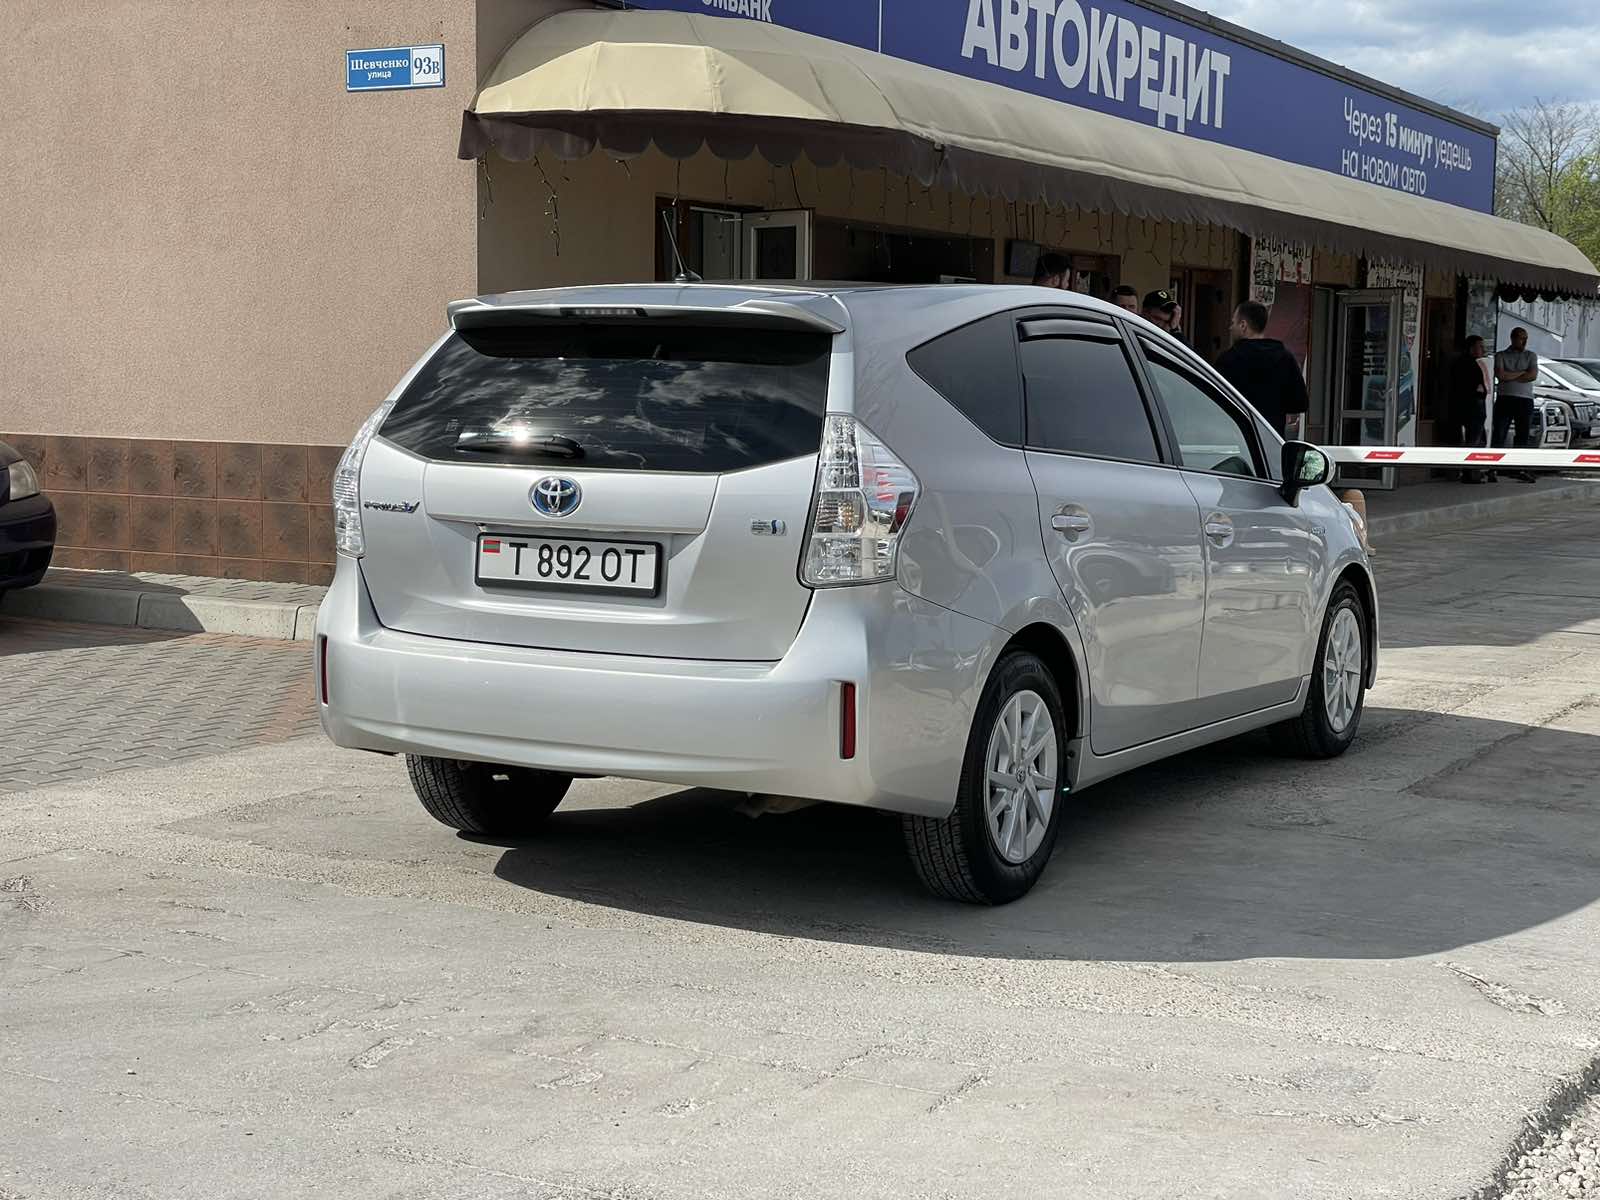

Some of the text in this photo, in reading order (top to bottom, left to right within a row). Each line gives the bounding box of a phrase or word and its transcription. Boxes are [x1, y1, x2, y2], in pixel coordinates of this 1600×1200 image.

[351, 58, 409, 71] Шевченко
[367, 70, 392, 81] улица
[961, 0, 1231, 133] АВТОКРЕДИТ
[1344, 97, 1472, 172] Через 15 минут уедешь
[1401, 165, 1427, 195] авто
[508, 542, 646, 584] T 892 OT
